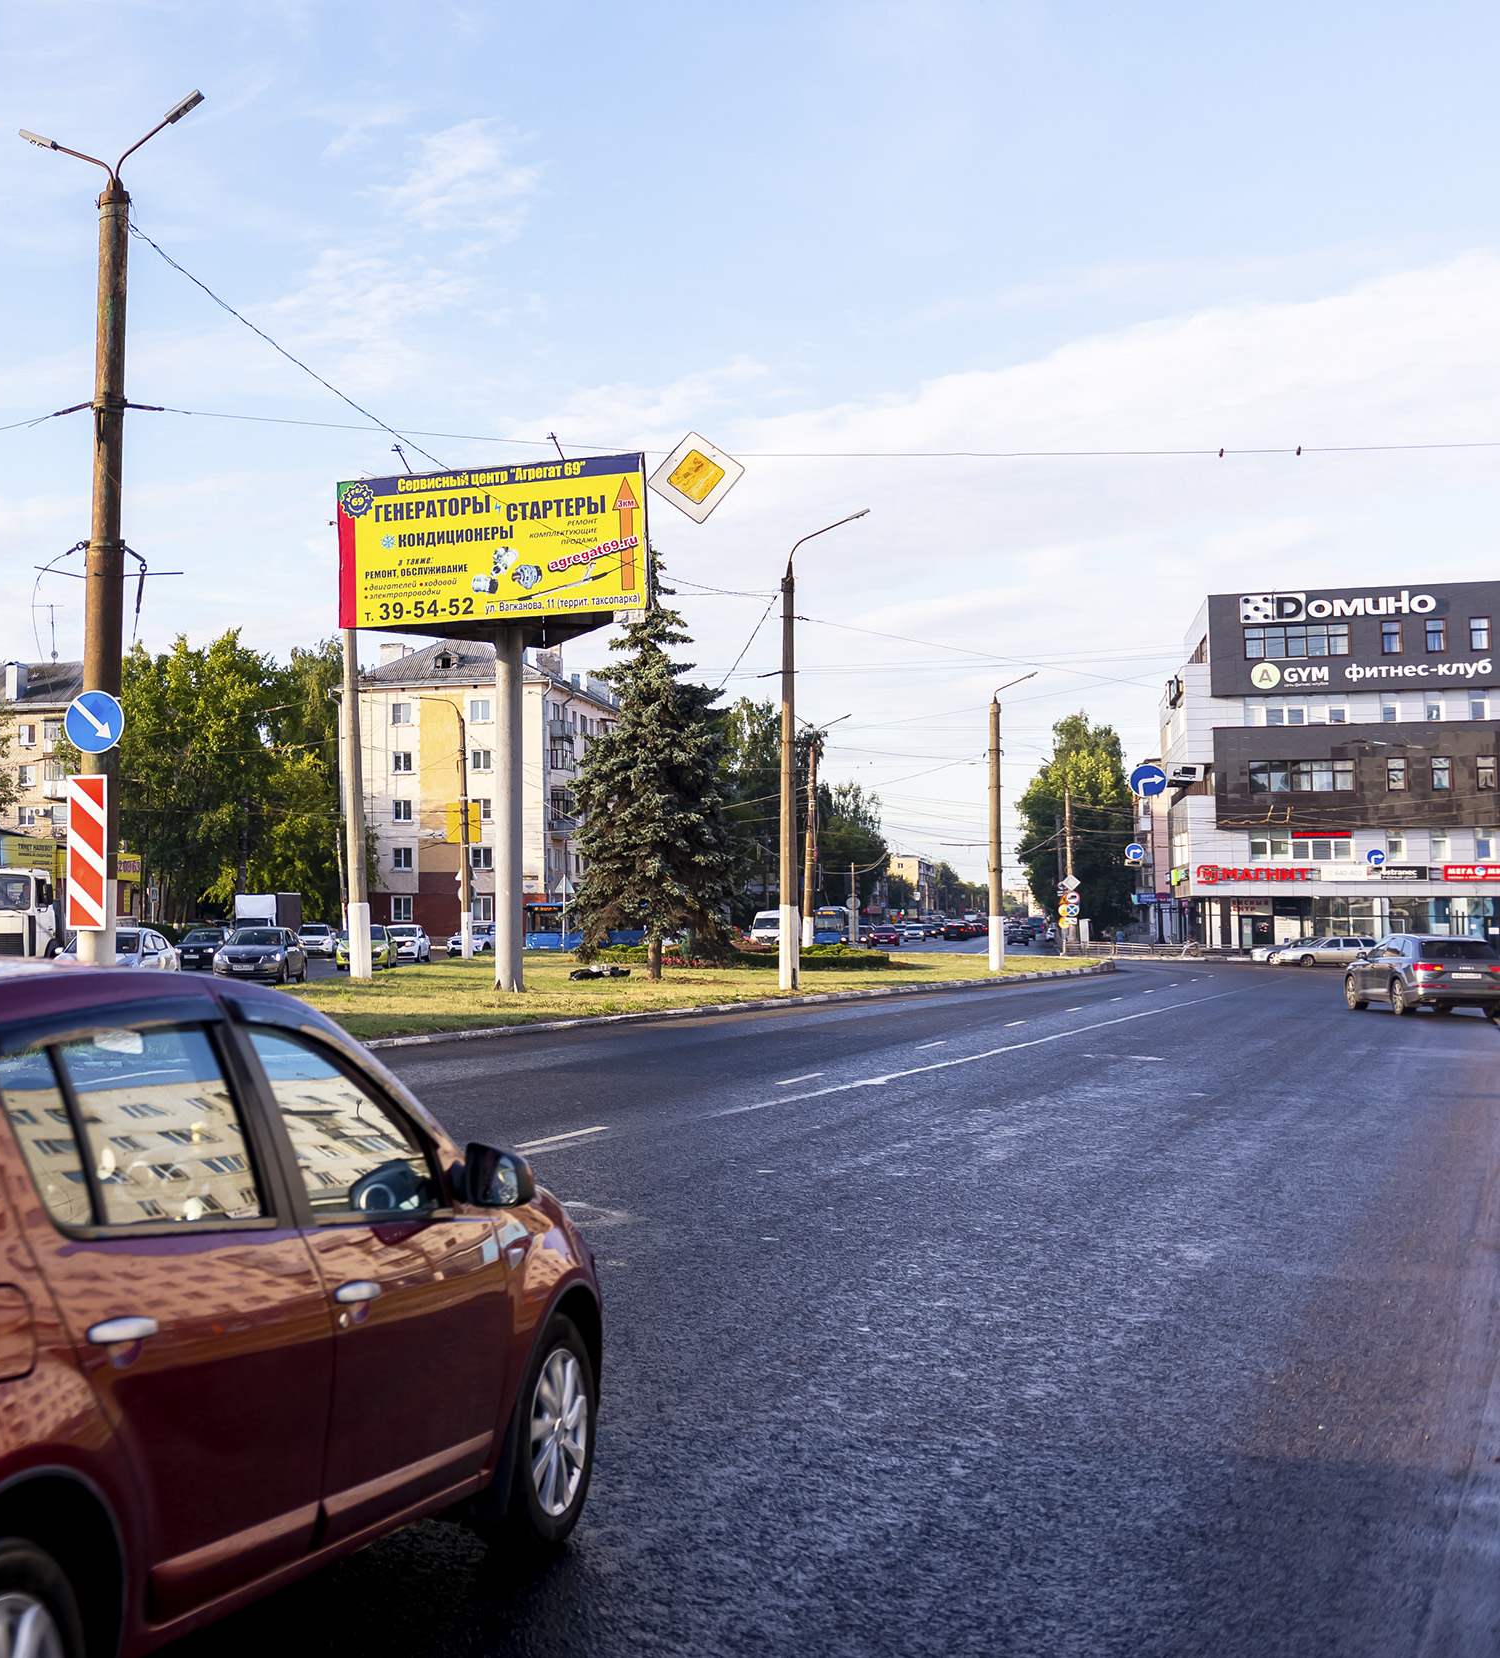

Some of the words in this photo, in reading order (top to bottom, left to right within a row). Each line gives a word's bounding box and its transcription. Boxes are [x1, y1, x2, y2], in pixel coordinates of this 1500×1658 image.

[397, 472, 469, 492] Сервисный
[470, 471, 508, 487] центр
[351, 497, 364, 506] 69
[375, 495, 490, 522] ГЕНЕРАТОРЫ
[506, 495, 606, 522] СТАРТЕРЫ
[567, 518, 598, 526] РЕМОНТ
[398, 525, 514, 548] КОНДИЦИОНЕРЫ
[529, 527, 598, 539] КОМПЛЕКТУЮЩИЕ
[561, 536, 598, 545] ПРОДАЖА
[549, 536, 639, 570] agregat69.ru
[406, 557, 434, 566] также:
[400, 564, 468, 577] ОБСЛУЖИВАНИЕ
[369, 581, 417, 592] двигателей
[424, 577, 458, 588] ходовой
[369, 588, 441, 600] электропроводки
[379, 597, 474, 621] 39-54-52
[485, 604, 497, 615] ул.
[499, 601, 545, 612] Вагжанова,
[546, 599, 555, 609] 11
[557, 598, 590, 610] (террит.
[591, 592, 641, 606] таксопарка)
[1283, 666, 1329, 683] GYM
[1344, 658, 1493, 682] фитнес-клуб
[1221, 867, 1310, 881] МАГНИТ
[1334, 869, 1363, 877] 640-602
